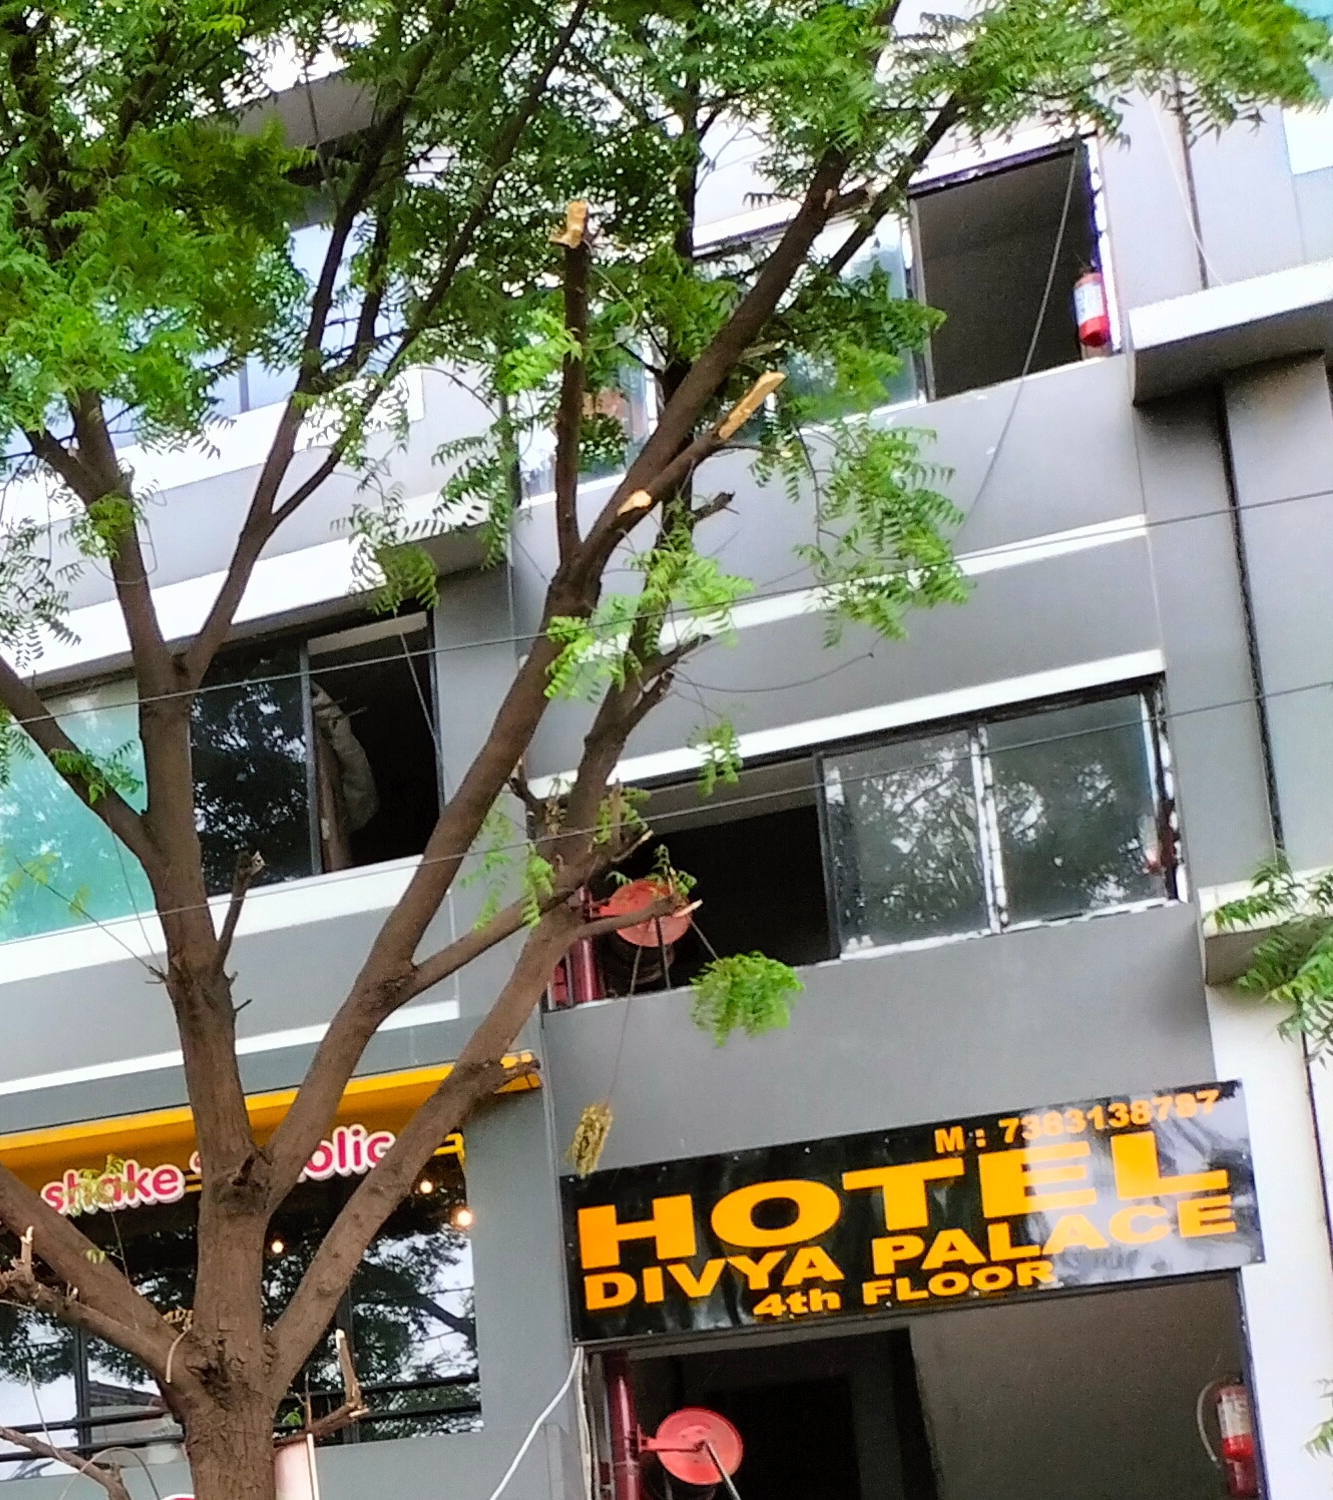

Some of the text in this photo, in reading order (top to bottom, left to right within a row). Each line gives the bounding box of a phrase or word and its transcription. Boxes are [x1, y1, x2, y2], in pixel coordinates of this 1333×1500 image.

[933, 1126, 965, 1155] M
[997, 1090, 1221, 1146] 7383138787
[577, 1130, 1230, 1271] HOTEL
[582, 1194, 1237, 1312] DIVYA PALACE
[752, 1259, 1056, 1318] 4th FLOOR
